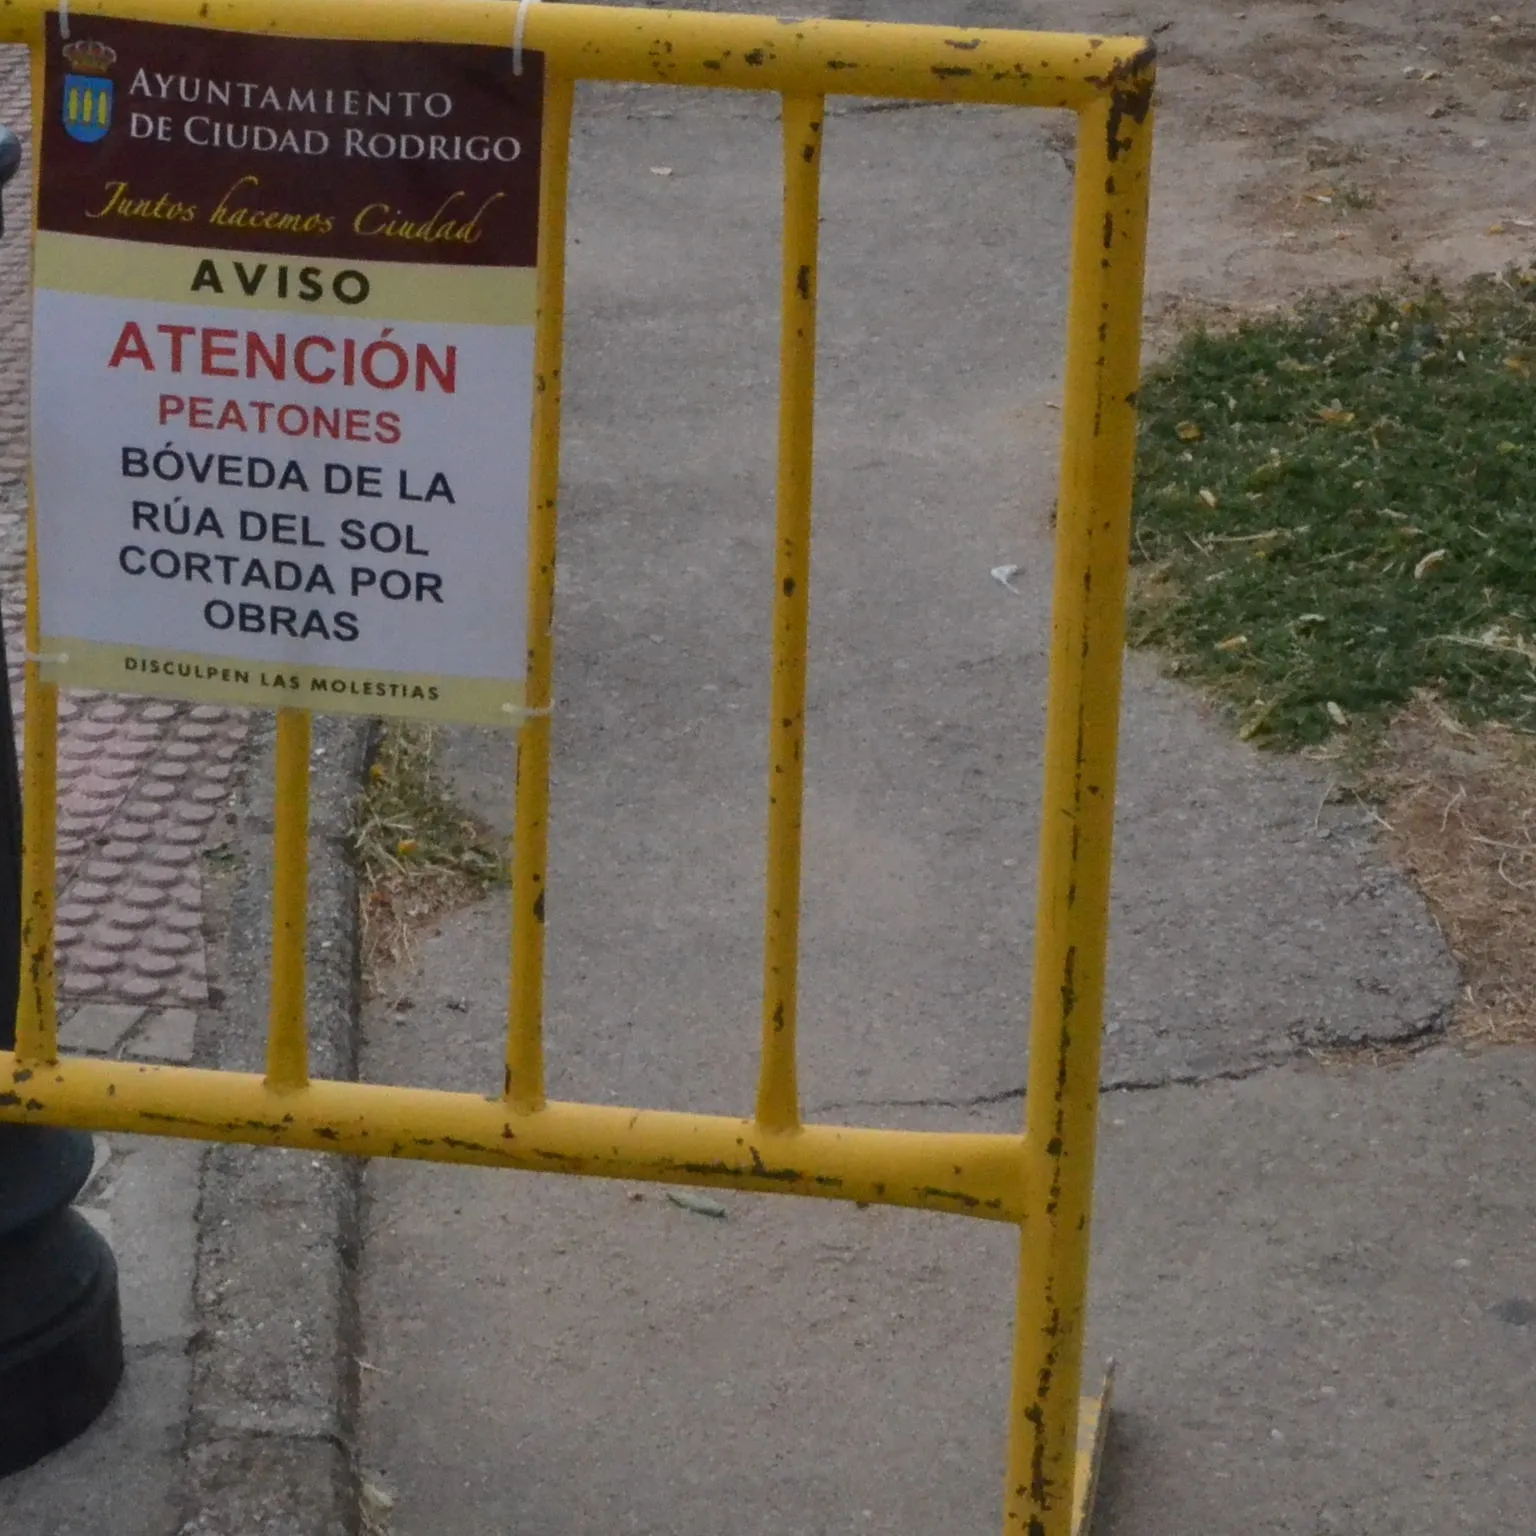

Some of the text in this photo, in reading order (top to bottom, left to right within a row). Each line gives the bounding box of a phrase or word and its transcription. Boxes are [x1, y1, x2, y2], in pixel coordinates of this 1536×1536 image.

[128, 67, 453, 118] AYUNTAMIENTO
[129, 112, 522, 163] DE CIUDAD RODRIGO
[85, 175, 505, 244] Juntos hacemos Ciudad
[190, 259, 370, 305] AVISO
[108, 320, 457, 394] ATENCIÓN
[158, 394, 402, 445] PEATONES
[120, 442, 456, 504] BÓVEDA DE LA
[131, 495, 430, 556] RÚA DEL SOL
[118, 545, 444, 604] CORTADA POR
[203, 599, 359, 642] OBRAS
[124, 656, 440, 701] DISCULPEN LAS MOLESTIAS
